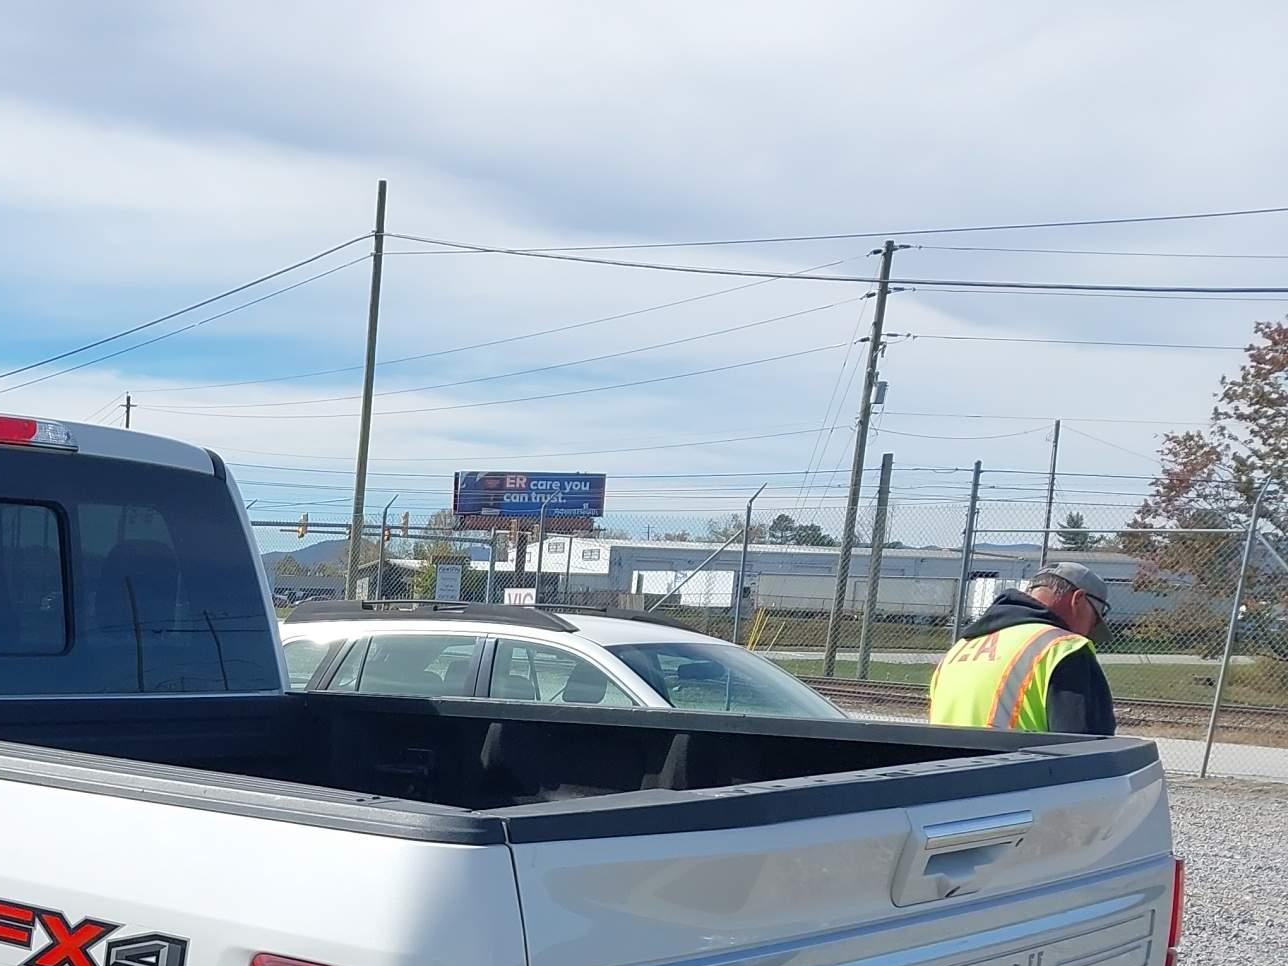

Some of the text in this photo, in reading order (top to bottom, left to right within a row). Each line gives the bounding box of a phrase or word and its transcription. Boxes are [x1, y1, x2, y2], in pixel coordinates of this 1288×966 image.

[506, 475, 590, 492] ER care you
[503, 491, 567, 503] can trust.
